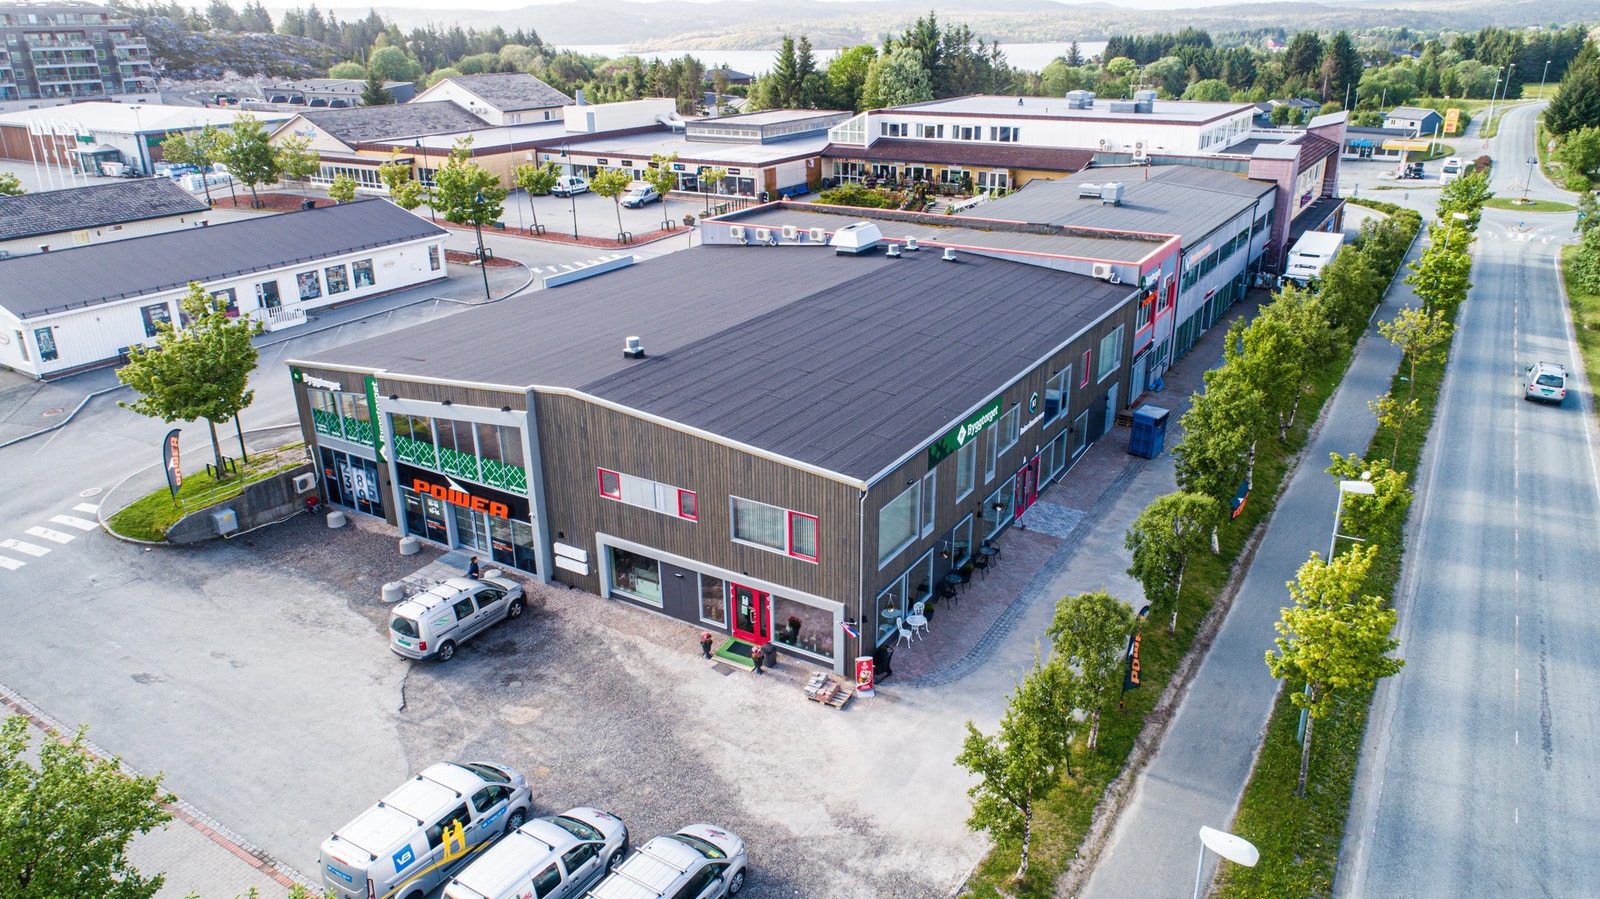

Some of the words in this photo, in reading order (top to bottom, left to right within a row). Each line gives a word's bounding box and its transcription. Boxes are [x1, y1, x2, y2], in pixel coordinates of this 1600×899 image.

[967, 405, 999, 436] Byggtorget
[356, 474, 364, 488] 8
[413, 478, 509, 520] POWER
[396, 851, 412, 866] VB
